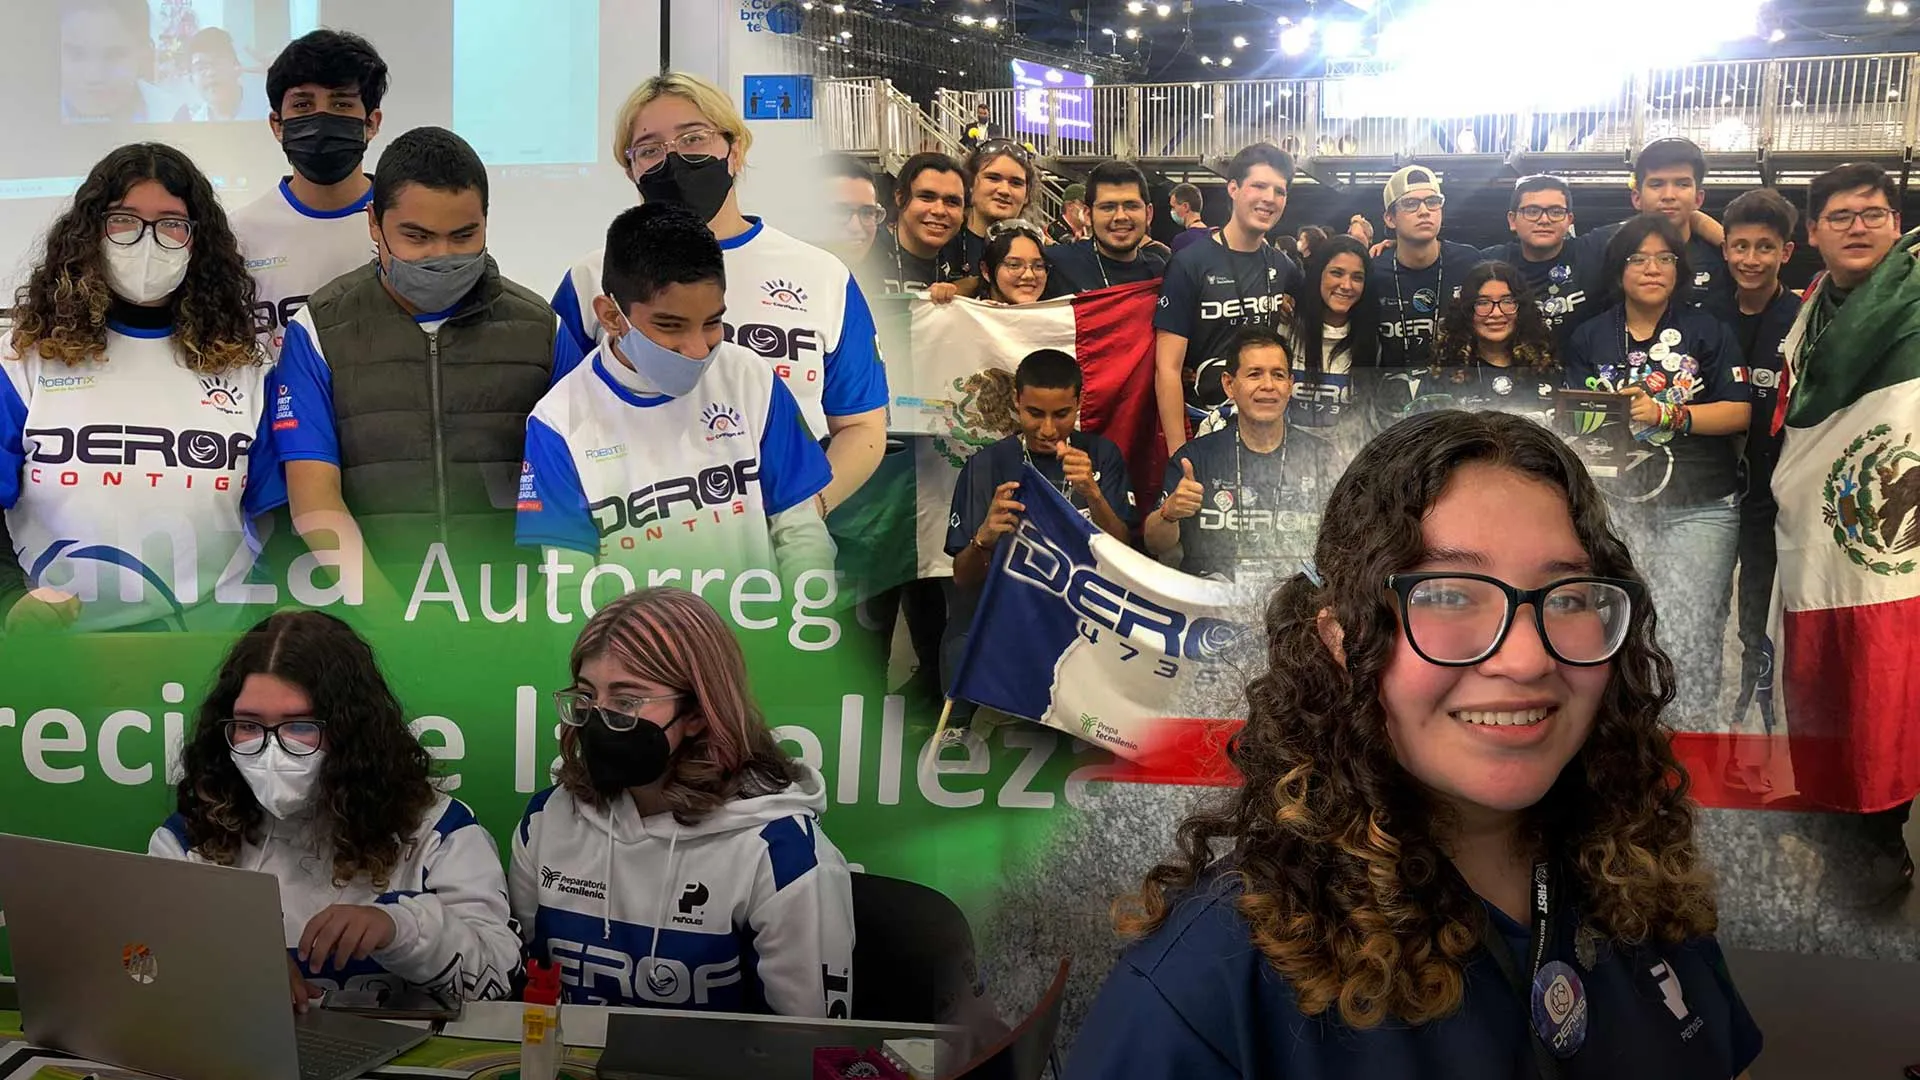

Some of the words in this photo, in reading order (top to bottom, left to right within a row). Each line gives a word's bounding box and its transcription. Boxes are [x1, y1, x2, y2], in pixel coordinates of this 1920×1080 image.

[31, 468, 247, 491] CONTIG
[1095, 729, 1138, 750] Tecmilenio
[1097, 721, 1119, 735] Prepa
[514, 685, 566, 793] l
[772, 694, 1122, 812] ellez
[1537, 884, 1548, 914] FIRST
